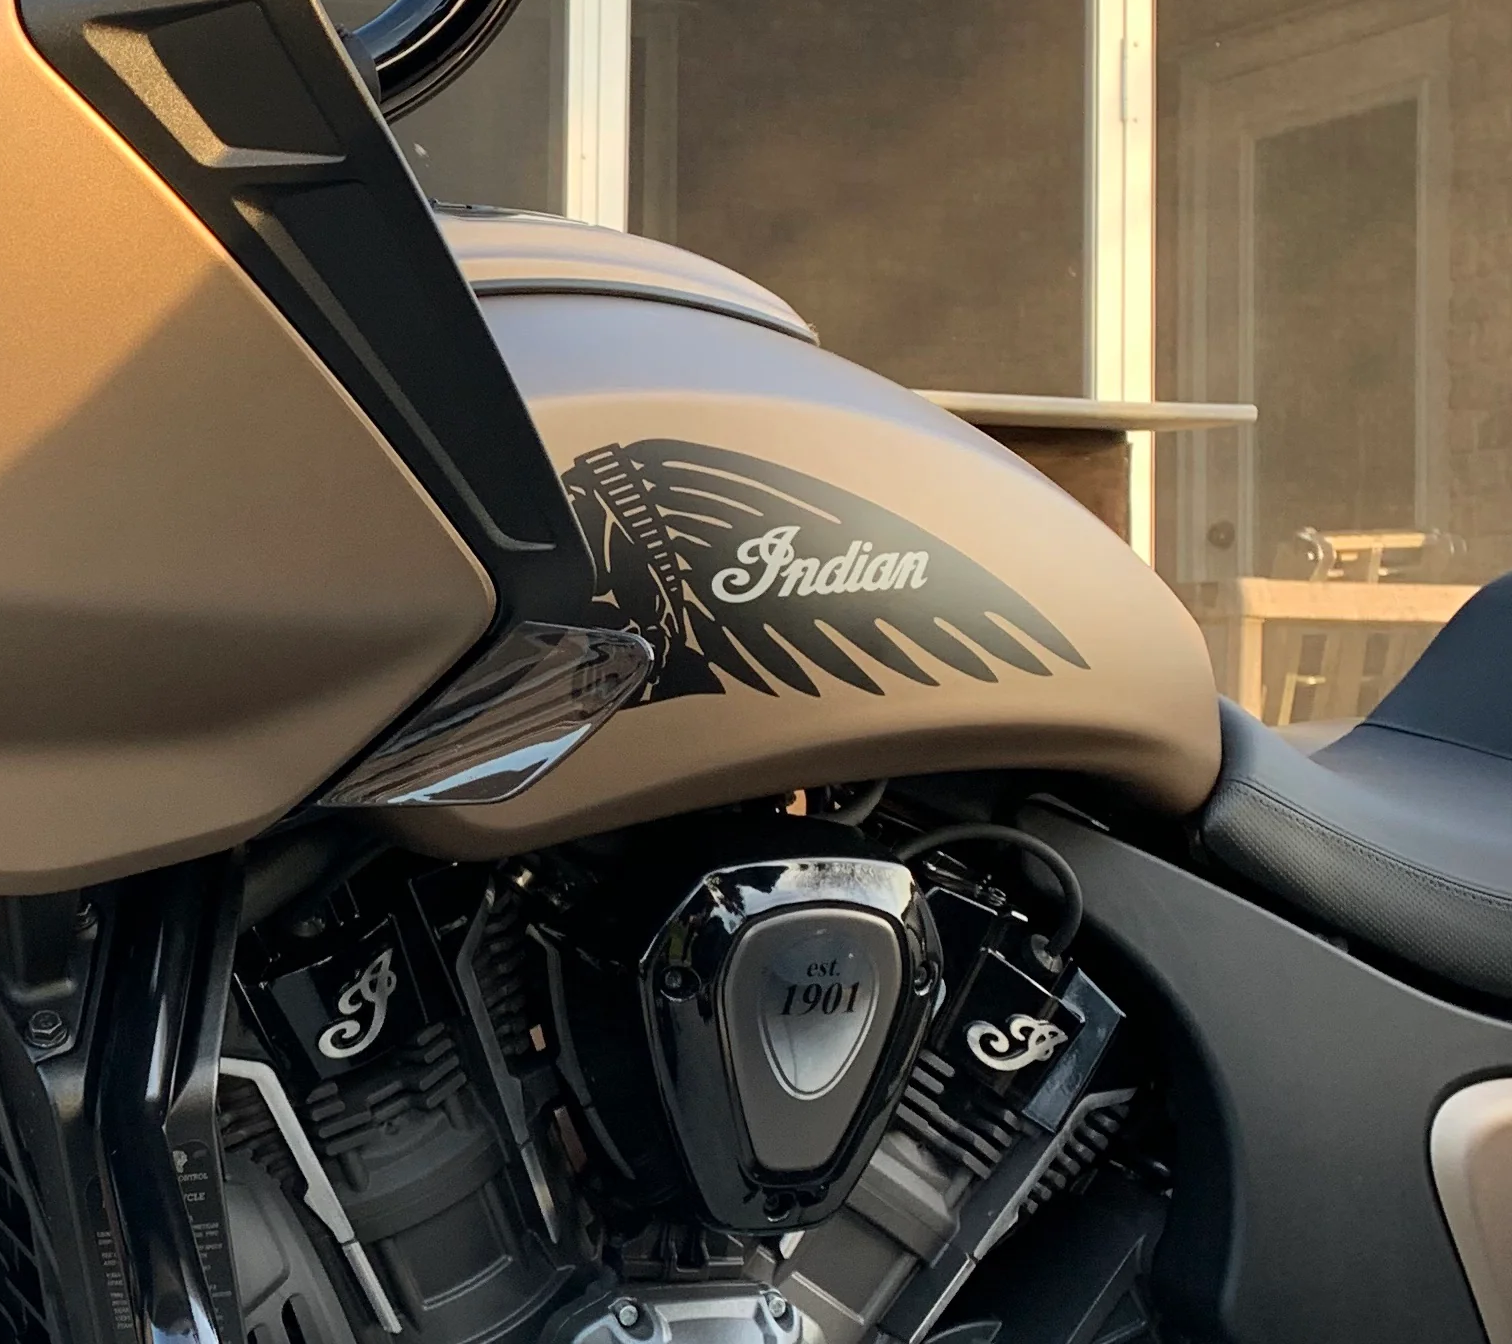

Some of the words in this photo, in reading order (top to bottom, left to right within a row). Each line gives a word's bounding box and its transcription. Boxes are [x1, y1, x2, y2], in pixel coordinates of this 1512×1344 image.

[711, 525, 929, 603] Indian
[807, 958, 840, 977] est.
[780, 981, 860, 1015] 1901
[177, 1172, 208, 1183] ONTROL
